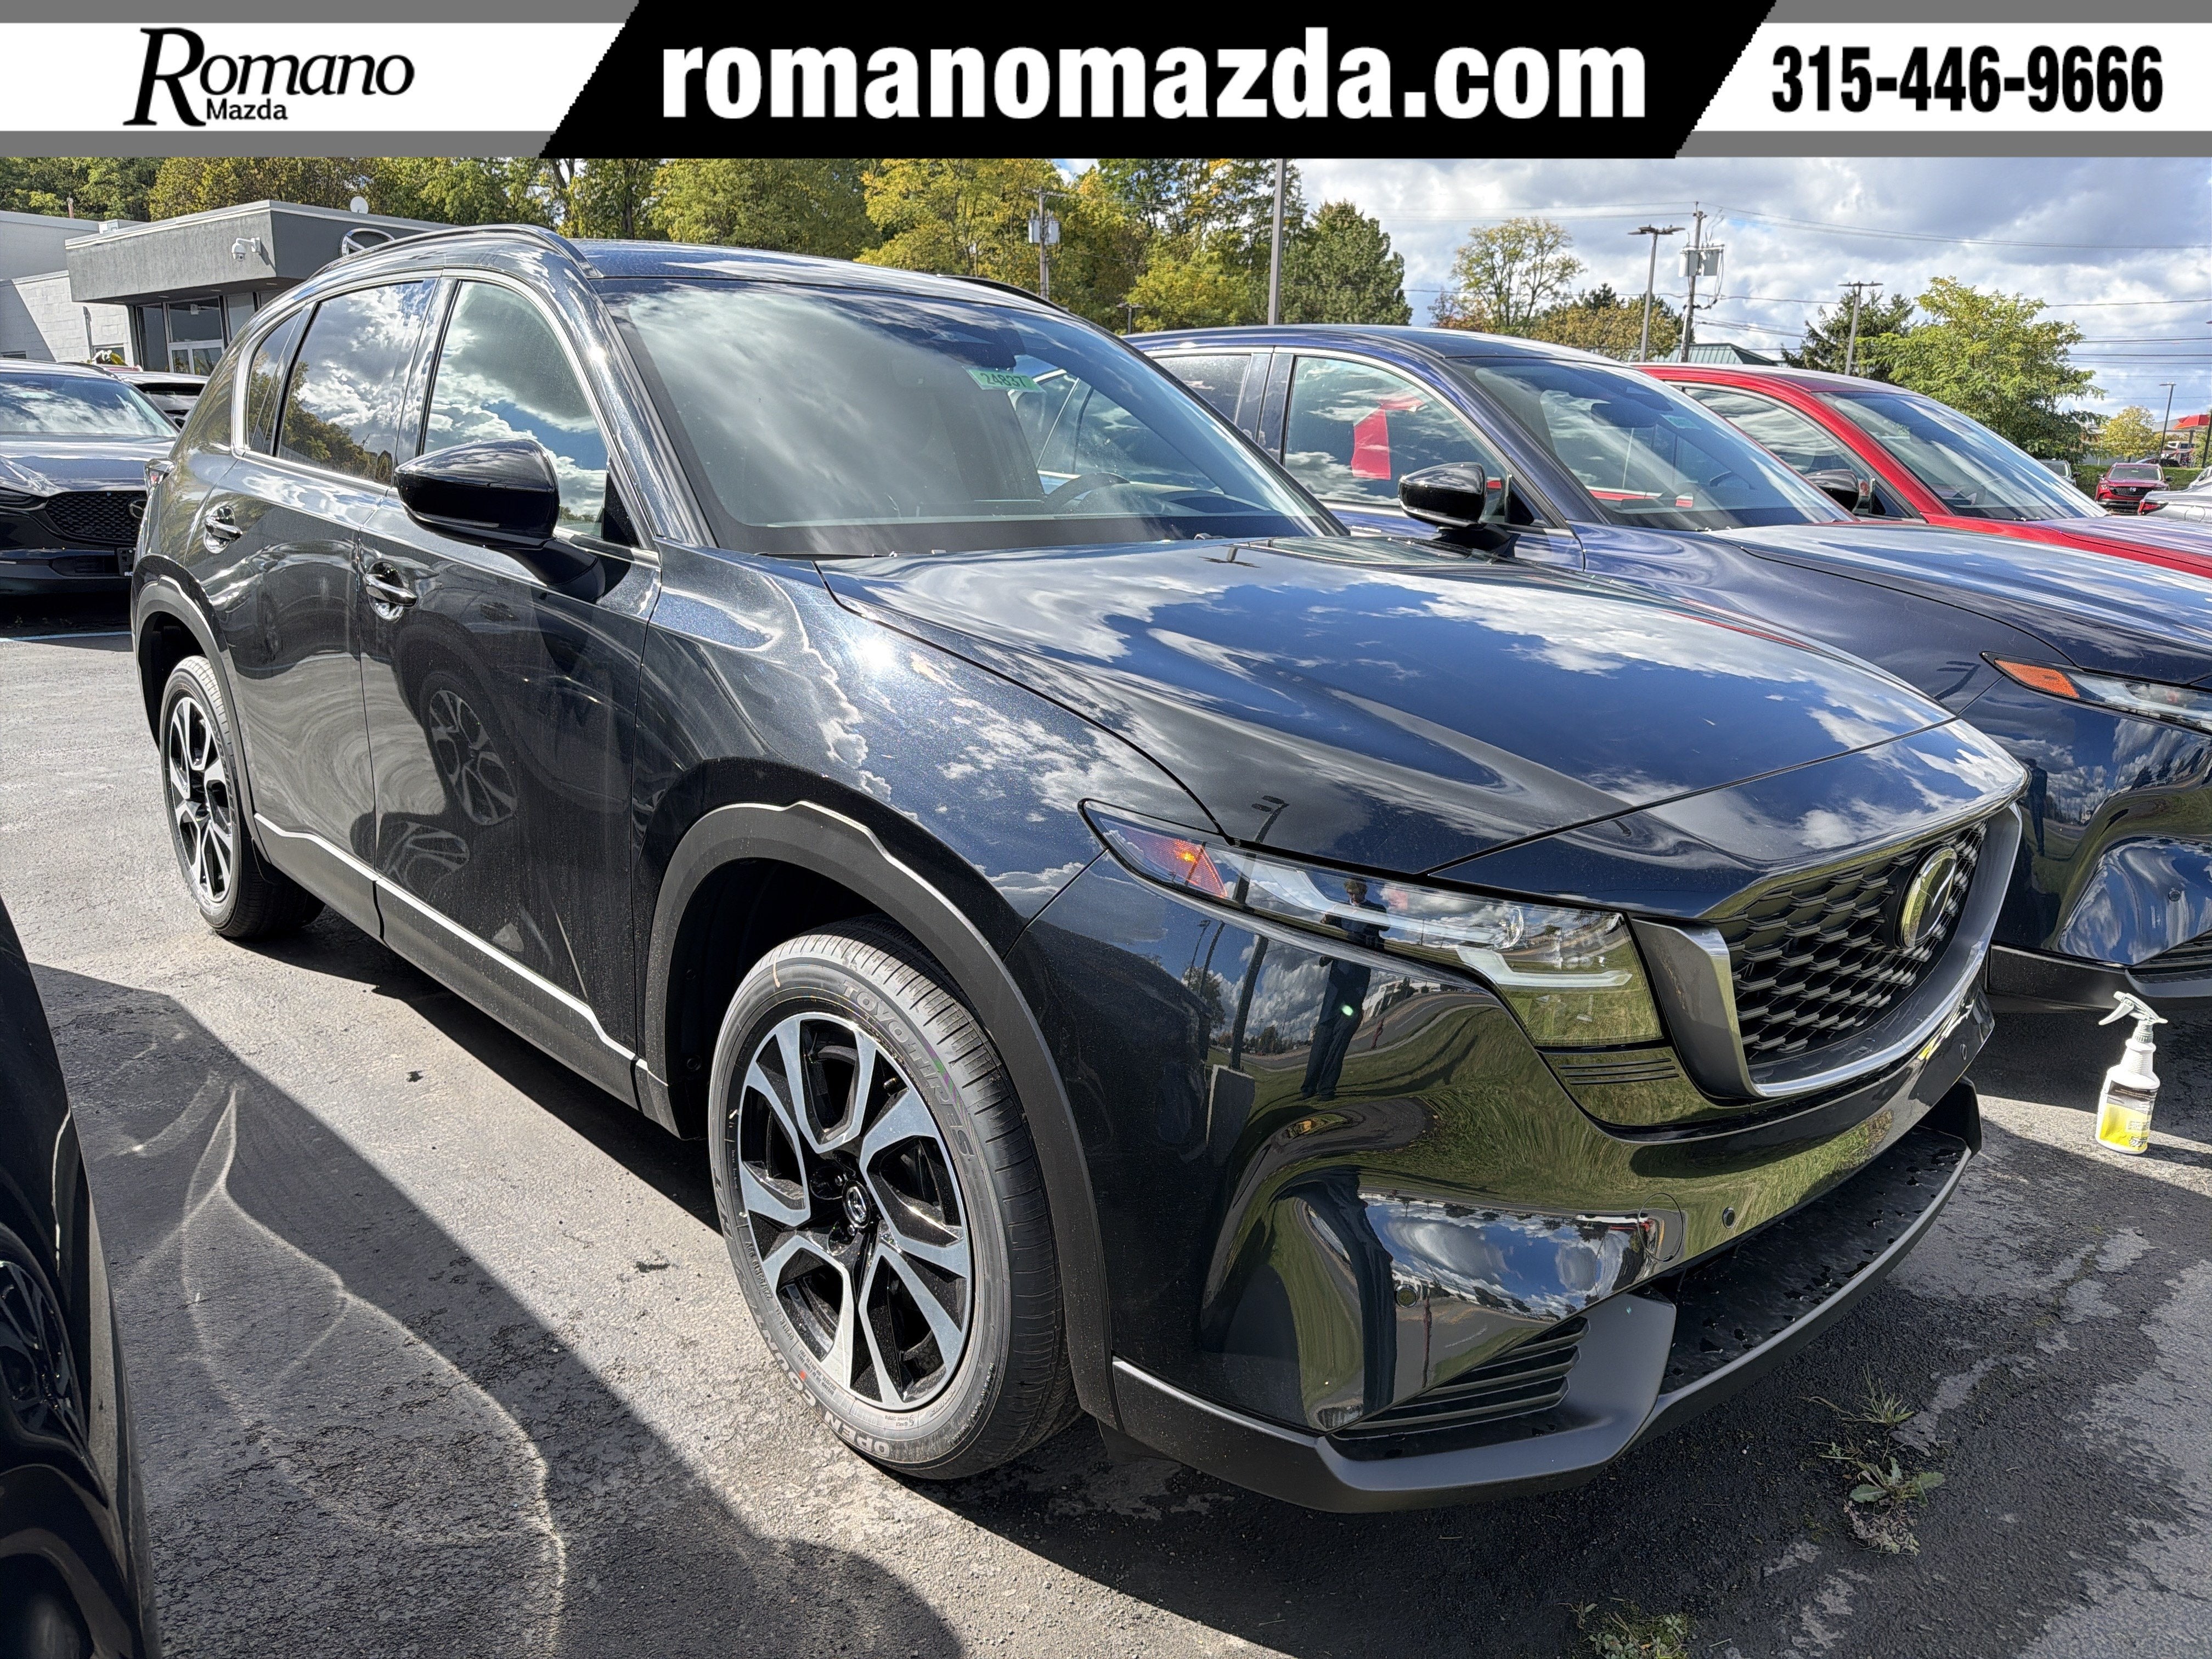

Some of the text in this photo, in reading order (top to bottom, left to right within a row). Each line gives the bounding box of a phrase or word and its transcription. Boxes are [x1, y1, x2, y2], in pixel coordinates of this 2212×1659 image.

[980, 373, 1027, 387] 24837
[843, 981, 975, 1158] TOYO TIRES
[825, 1412, 890, 1458] OPEN
